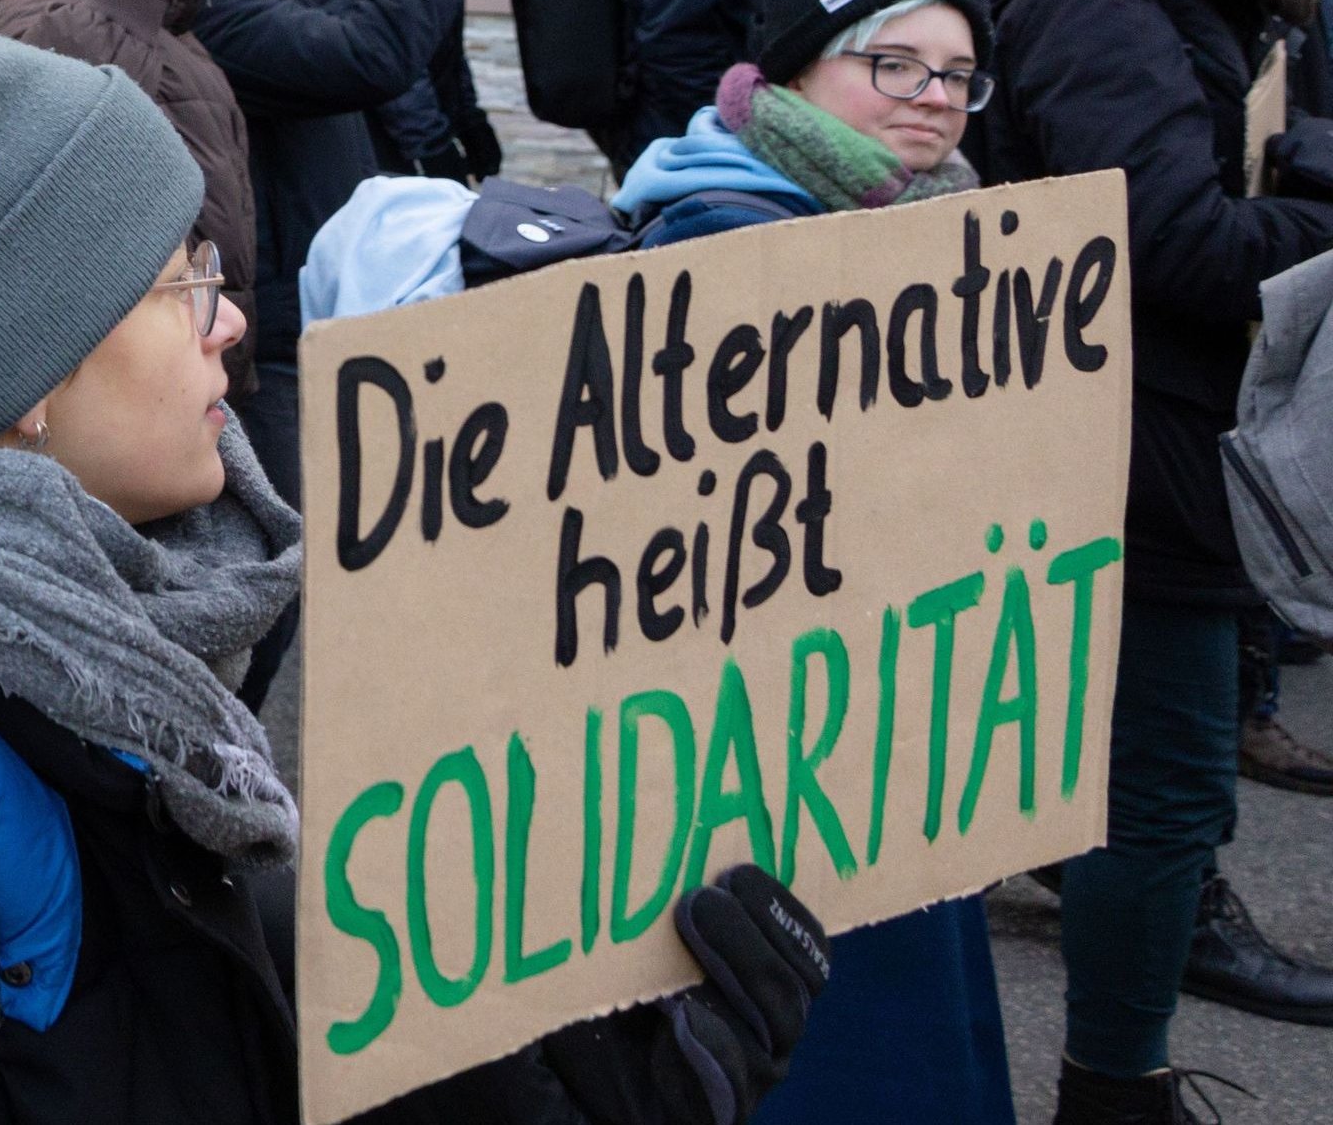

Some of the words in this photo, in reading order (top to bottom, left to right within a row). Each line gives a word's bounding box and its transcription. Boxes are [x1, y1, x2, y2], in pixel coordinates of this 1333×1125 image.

[336, 354, 509, 572] Die
[547, 209, 1117, 501] Alternative
[555, 443, 843, 668] heißt
[326, 519, 1122, 1057] SOLIDARITÄT
